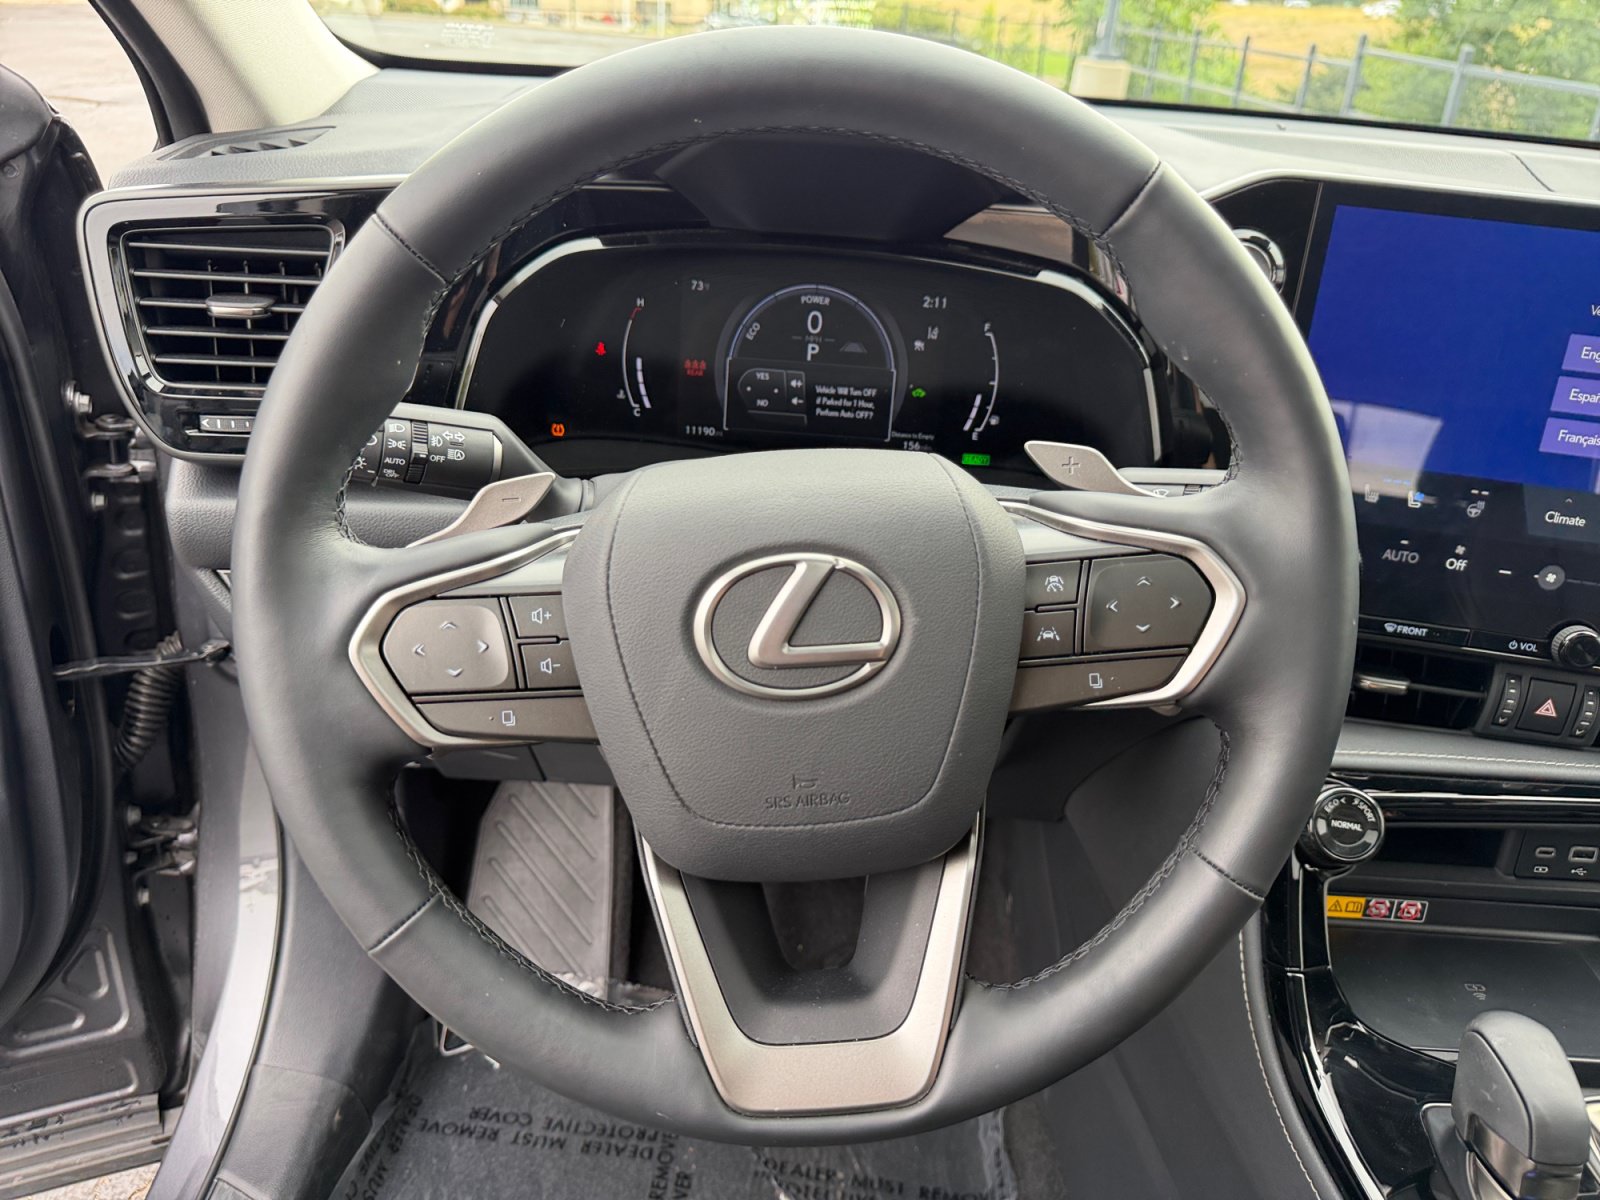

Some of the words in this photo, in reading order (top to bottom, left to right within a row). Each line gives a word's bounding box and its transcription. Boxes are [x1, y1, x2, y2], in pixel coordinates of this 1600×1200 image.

[636, 298, 645, 307] H
[800, 295, 831, 306] POWER
[922, 295, 948, 309] 2:11
[807, 310, 823, 334] 0
[984, 322, 991, 332] F
[746, 322, 761, 341] ECO
[806, 342, 820, 361] P
[756, 372, 770, 380] YES
[815, 384, 836, 394] Vehicle
[850, 387, 862, 396] Turn
[863, 388, 877, 397] OFF
[757, 399, 769, 407] NO
[822, 397, 842, 406] Parked
[843, 399, 852, 407] for
[633, 408, 641, 417] C
[840, 409, 855, 418] Auto
[856, 410, 874, 419] OFF?
[685, 425, 716, 437] 11190
[971, 431, 979, 441] E
[384, 457, 406, 466] AUTO
[430, 455, 446, 463] OFF
[1545, 511, 1586, 527] Climate
[1381, 548, 1419, 564] AUTO
[1445, 558, 1468, 572] Off
[1396, 625, 1428, 637] FRONT
[1520, 642, 1538, 653] VOL
[765, 796, 793, 809] SRS
[796, 791, 850, 808] AIRBAG
[1324, 799, 1339, 814] ECO
[1358, 801, 1376, 822] SPORT
[1331, 819, 1363, 832] NORMAL
[469, 1106, 533, 1127] COVER
[419, 1118, 500, 1142] REMOVE
[510, 1131, 567, 1151] MUST
[581, 1139, 654, 1160] DEALER
